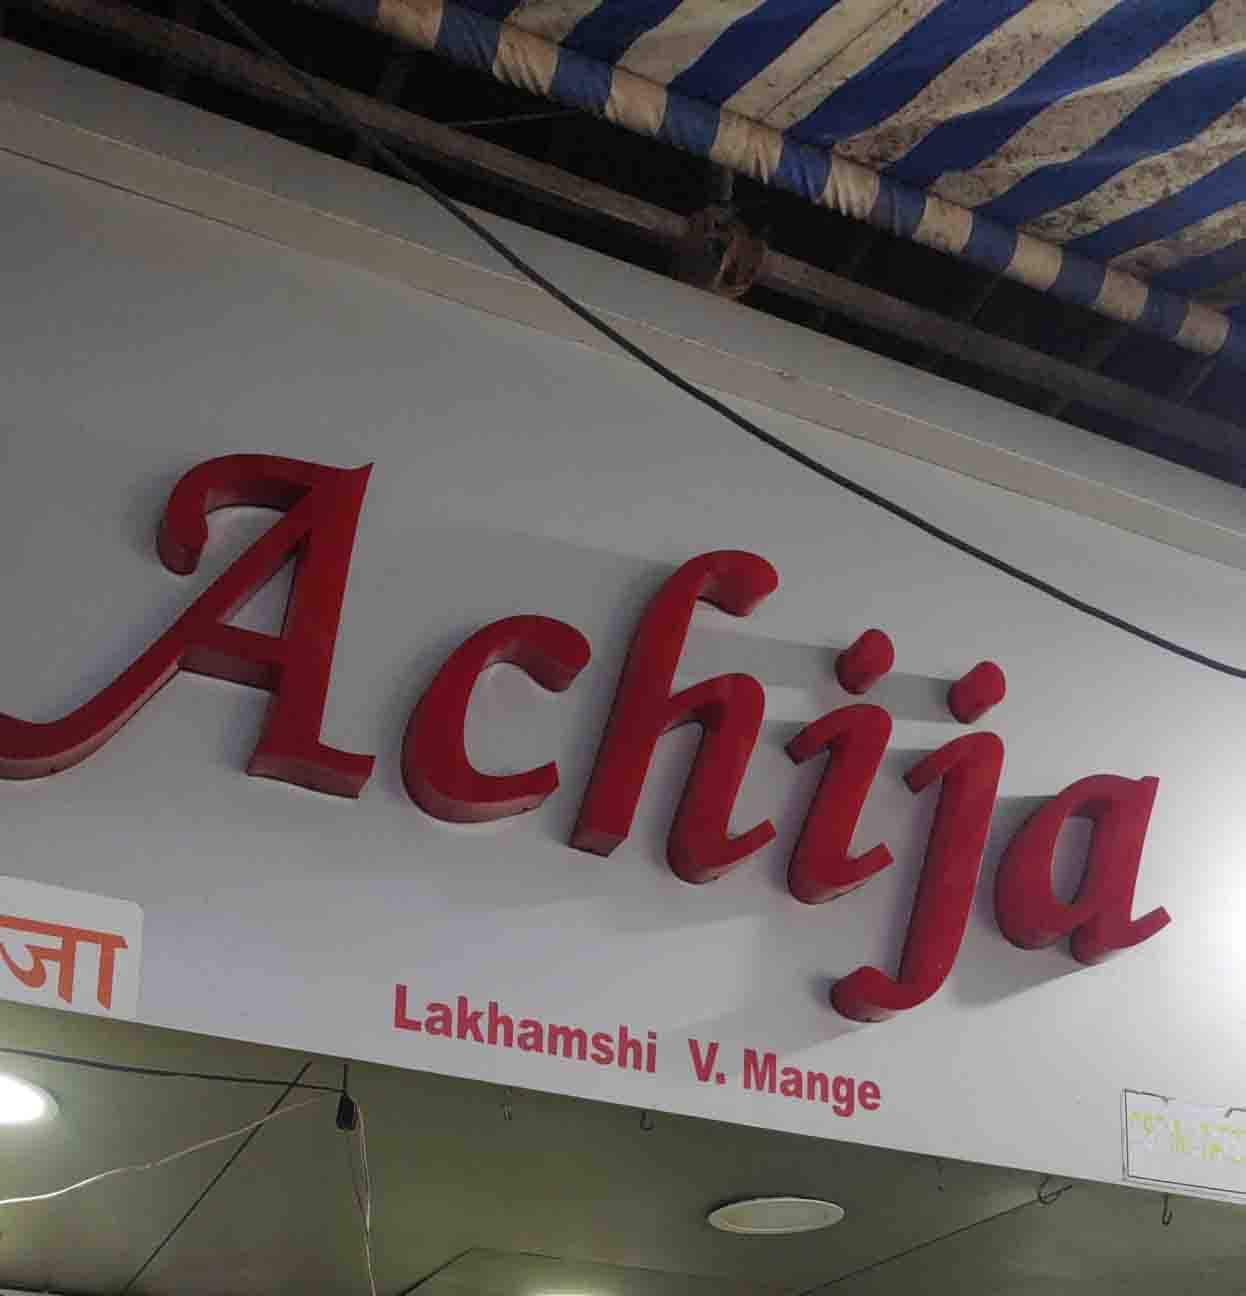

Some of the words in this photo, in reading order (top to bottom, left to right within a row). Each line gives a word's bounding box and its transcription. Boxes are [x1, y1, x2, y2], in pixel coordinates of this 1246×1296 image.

[0, 454, 1171, 1022] Achija
[393, 984, 657, 1073] Lakhamshi
[688, 1039, 727, 1085] V.
[743, 1049, 881, 1117] Mange
